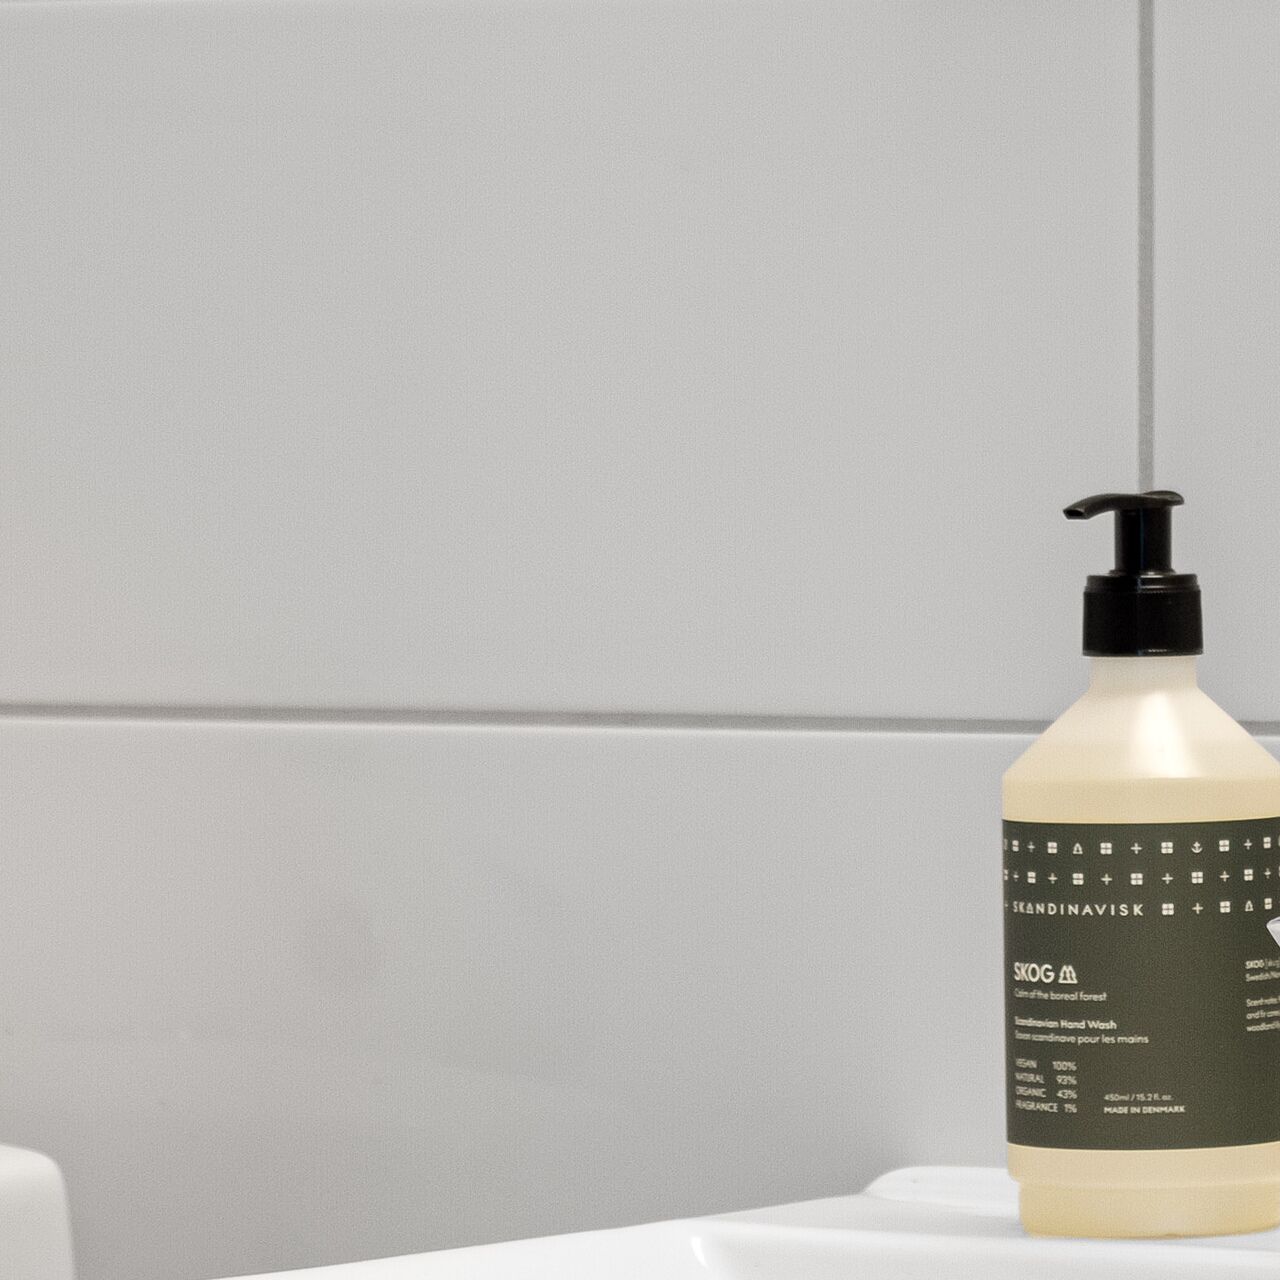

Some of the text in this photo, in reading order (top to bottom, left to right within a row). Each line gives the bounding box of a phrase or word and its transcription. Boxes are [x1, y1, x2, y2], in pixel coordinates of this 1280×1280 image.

[1013, 901, 1144, 917] SKANDINAVISK
[1014, 961, 1056, 983] SKOG
[1050, 991, 1078, 1001] boreal
[1080, 991, 1107, 1002] forest
[1060, 1019, 1085, 1030] Hand
[1087, 1020, 1117, 1030] Wash
[1077, 1035, 1100, 1045] pour
[1101, 1033, 1116, 1044] les
[1117, 1034, 1149, 1044] mains
[1052, 1060, 1077, 1071] 100%
[1056, 1075, 1077, 1085] 93%
[1056, 1089, 1078, 1099] 43%
[1064, 1103, 1078, 1113] 1%
[1103, 1105, 1186, 1114] MADE IN DENMARK
